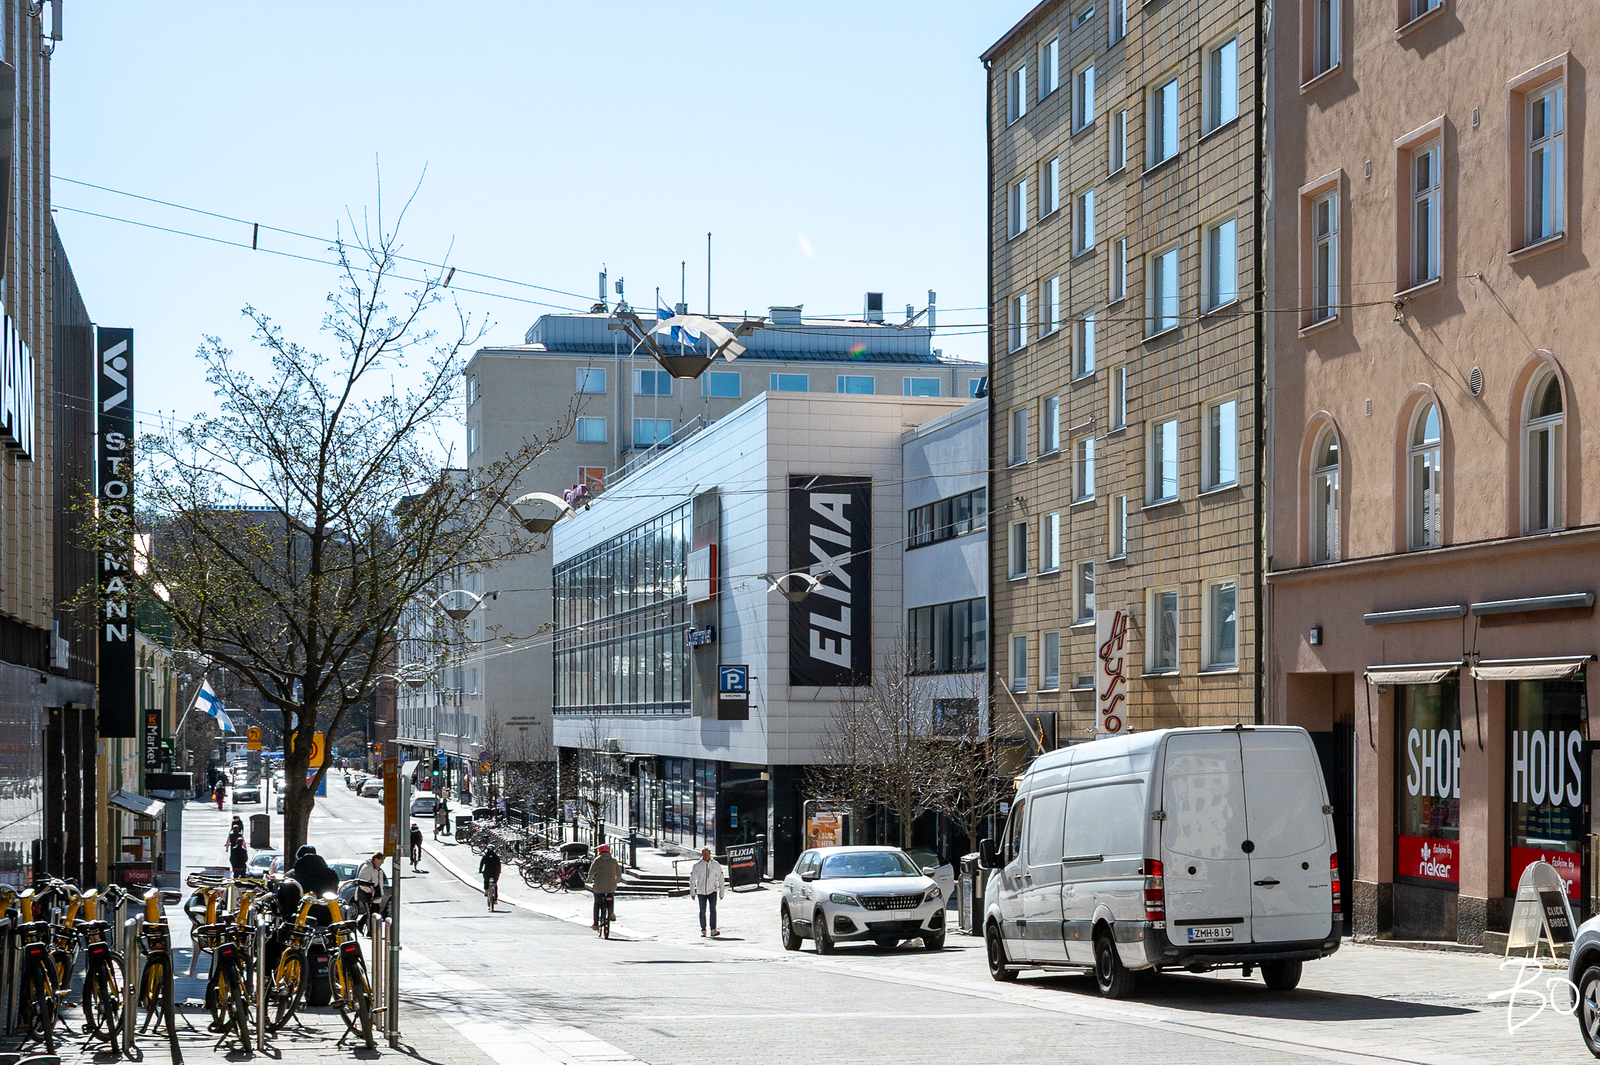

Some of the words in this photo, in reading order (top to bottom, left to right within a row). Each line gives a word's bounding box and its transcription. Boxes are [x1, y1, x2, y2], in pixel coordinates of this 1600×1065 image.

[810, 493, 851, 669] ELIXIA
[147, 726, 158, 764] Market
[730, 848, 754, 857] ELIXIA
[1419, 857, 1451, 878] rieker
[1547, 906, 1564, 916] CLICK
[1549, 918, 1569, 928] SHOES
[1194, 928, 1231, 938] ZMH-819
